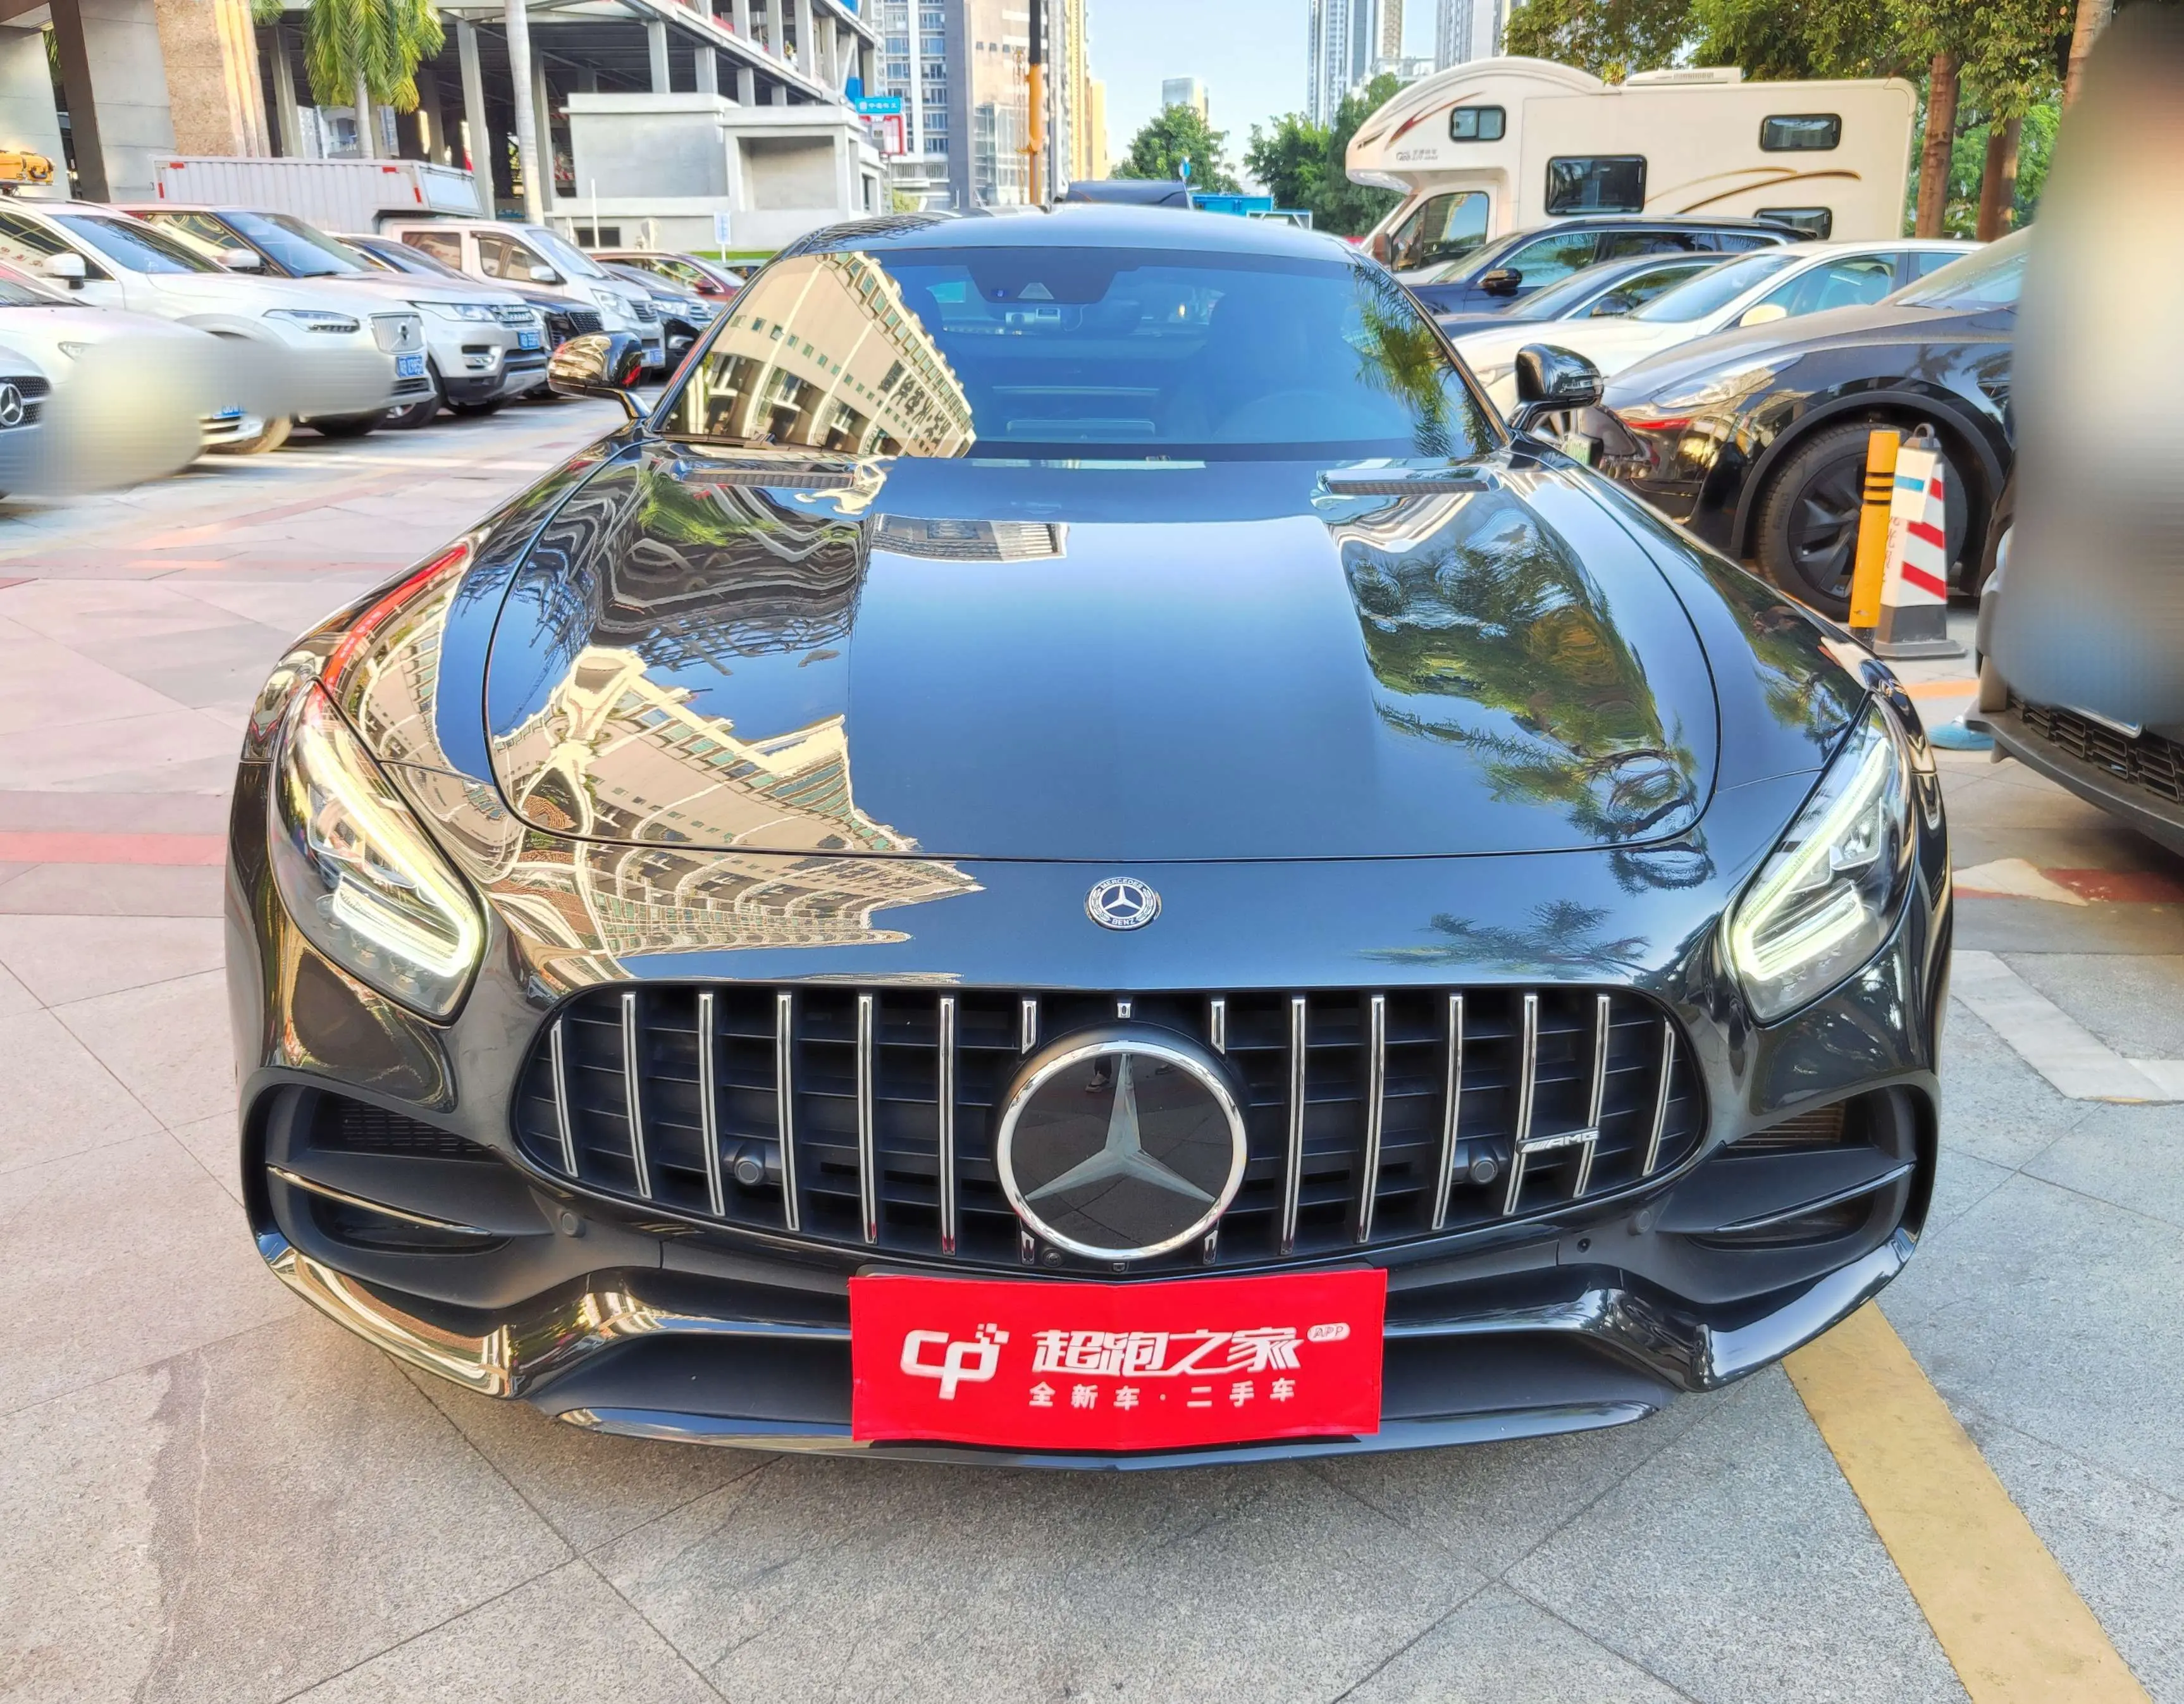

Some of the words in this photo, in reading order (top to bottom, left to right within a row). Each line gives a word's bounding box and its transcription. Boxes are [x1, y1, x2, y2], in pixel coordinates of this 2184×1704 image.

[1100, 879, 1144, 889] MERCEDES
[1111, 918, 1137, 926] BENZ
[1545, 1130, 1599, 1149] AMG
[1031, 1326, 1304, 1377] 超跑之家
[1311, 1324, 1346, 1339] APP
